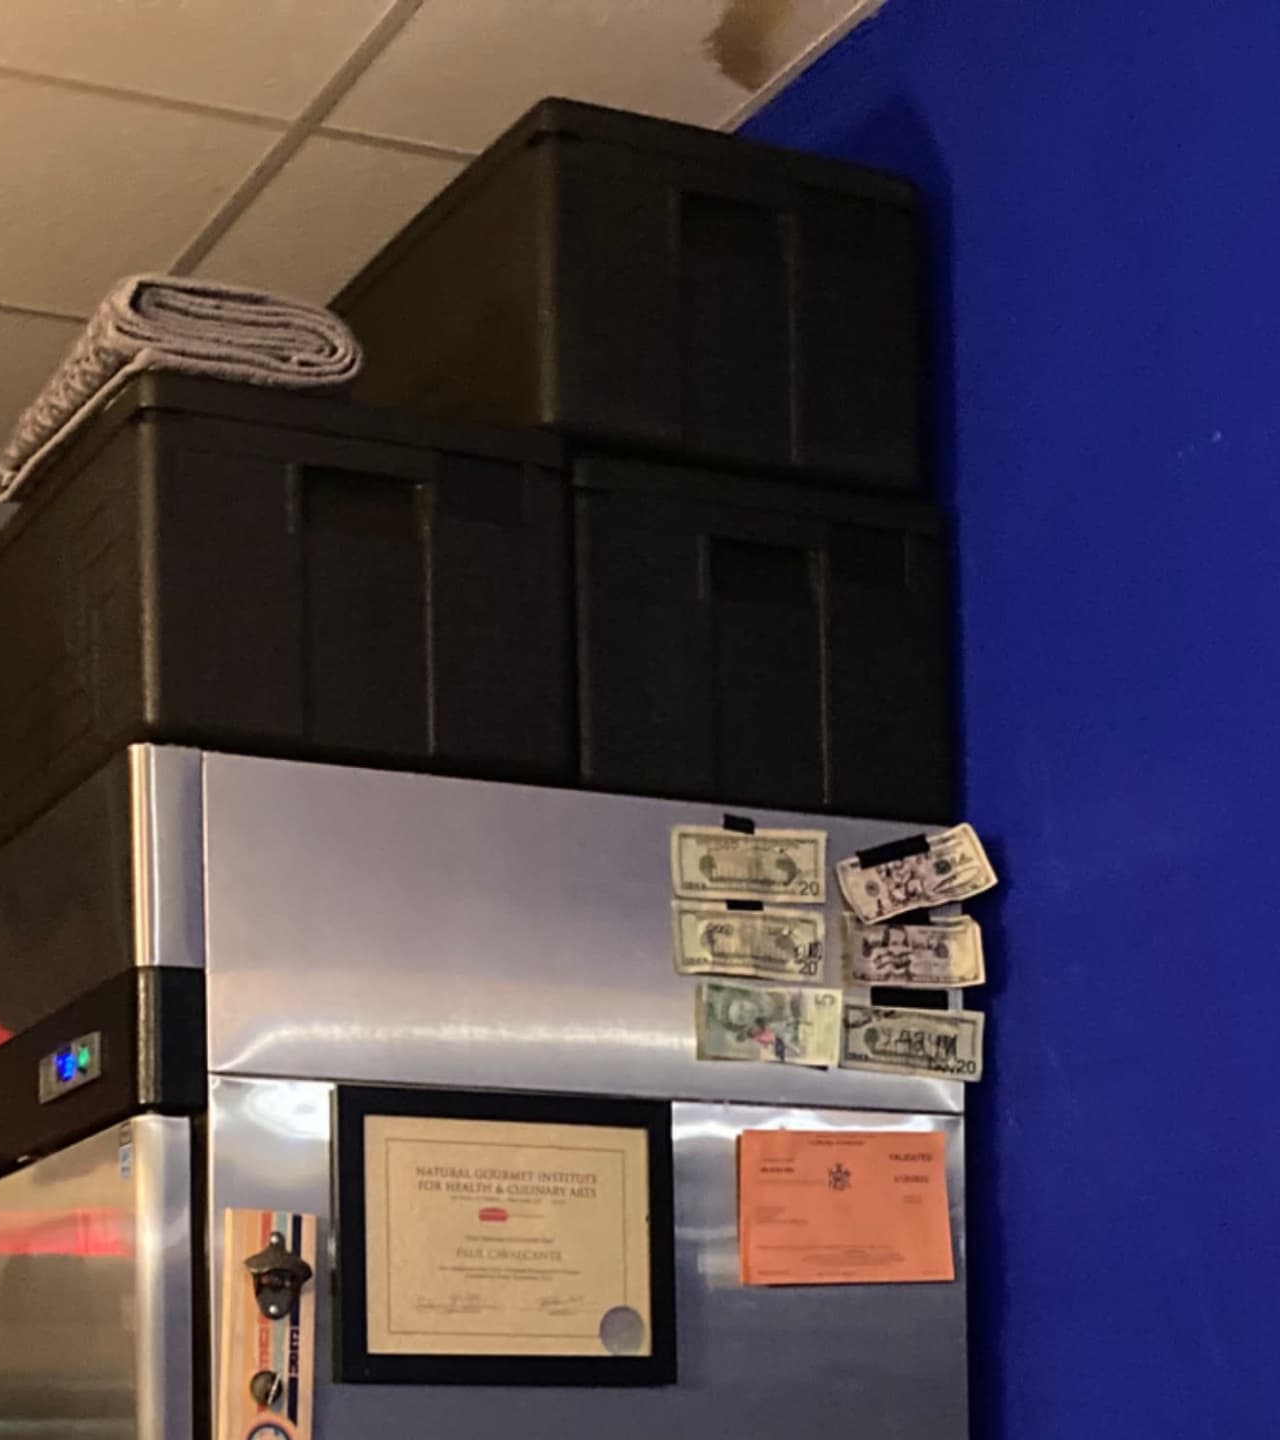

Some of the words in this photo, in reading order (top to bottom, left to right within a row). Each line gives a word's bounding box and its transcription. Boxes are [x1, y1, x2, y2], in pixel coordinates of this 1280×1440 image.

[800, 881, 820, 896] 20
[799, 961, 818, 976] 20
[957, 1060, 976, 1074] 20
[416, 1167, 471, 1179] NATURAL
[474, 1169, 534, 1181] GOURMET
[538, 1172, 598, 1184] INSTITUTE
[418, 1180, 441, 1191] FOR
[445, 1181, 492, 1193] HEALTH
[496, 1184, 504, 1193] &
[507, 1184, 566, 1197] CULINARY
[570, 1187, 597, 1198] ARTS
